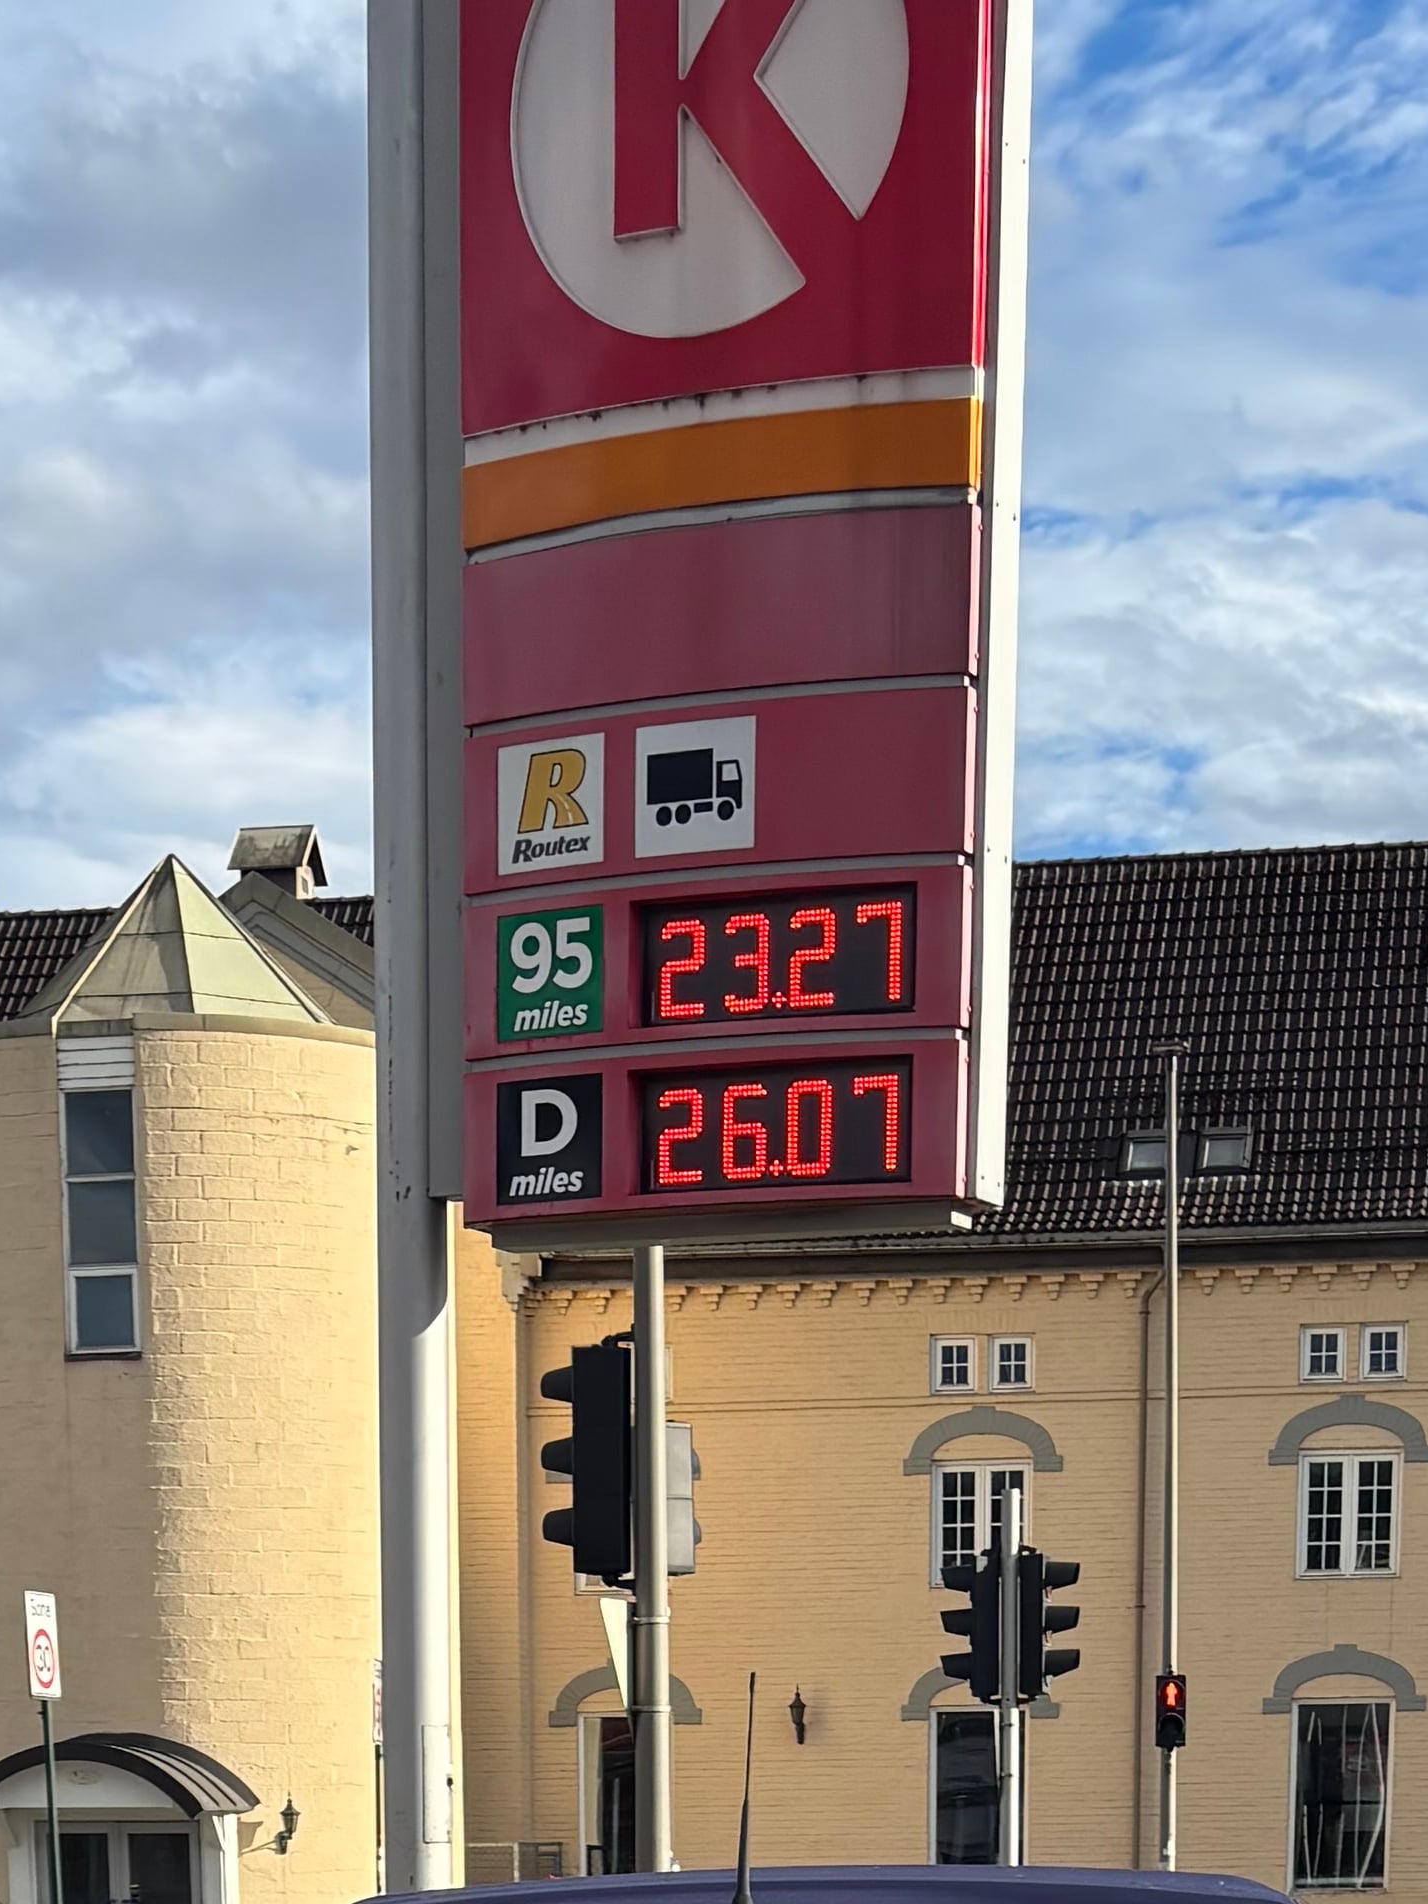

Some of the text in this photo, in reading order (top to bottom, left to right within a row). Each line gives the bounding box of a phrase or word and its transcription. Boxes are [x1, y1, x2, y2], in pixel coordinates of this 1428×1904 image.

[517, 748, 590, 834] R
[511, 836, 591, 864] Routex
[509, 900, 903, 1019] 95 23.27
[513, 1001, 589, 1033] miles
[520, 1073, 900, 1187] D 26.07
[509, 1167, 583, 1198] miles
